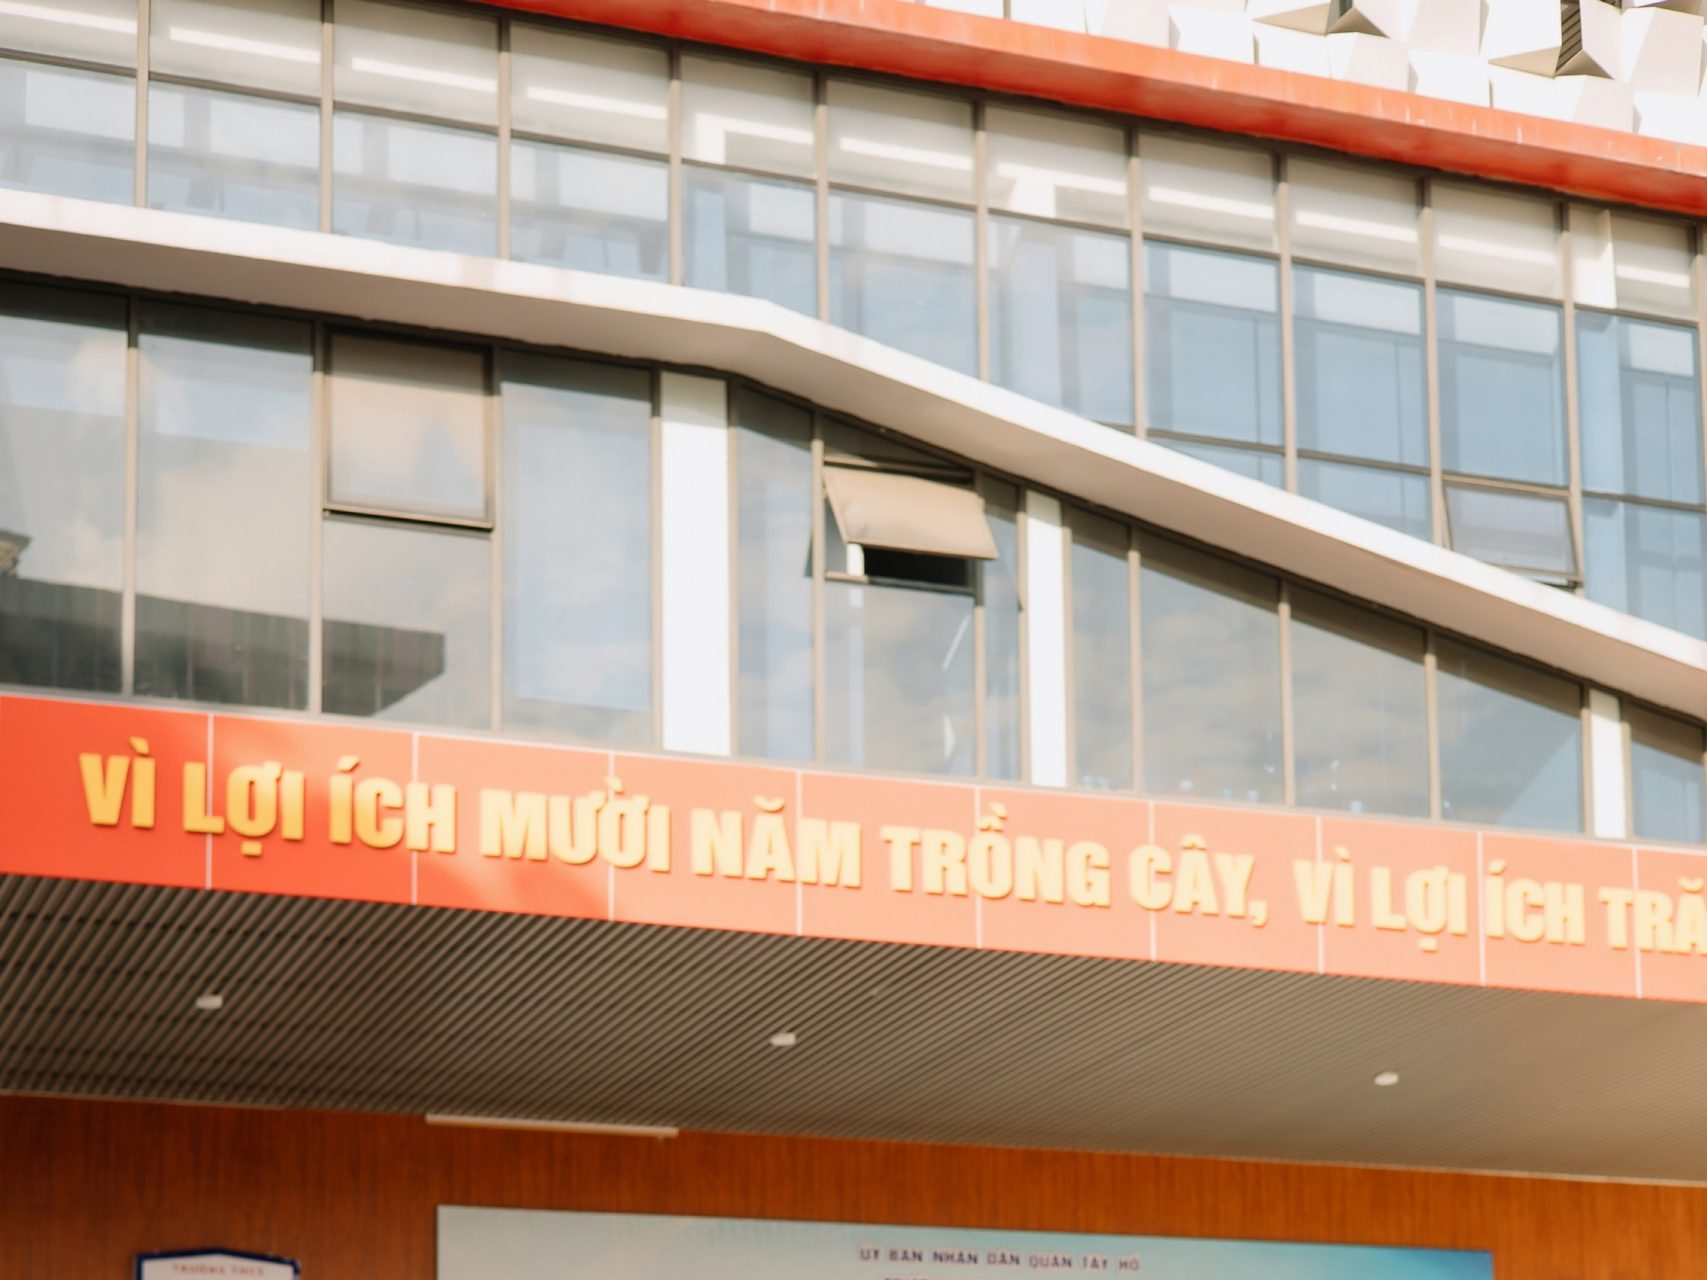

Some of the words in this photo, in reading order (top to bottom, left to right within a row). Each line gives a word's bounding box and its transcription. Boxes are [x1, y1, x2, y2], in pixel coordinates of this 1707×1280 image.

[79, 737, 155, 829] VÌ
[183, 760, 304, 857] LỢI
[328, 755, 457, 853] ÍCH
[479, 776, 670, 872] MƯỜI
[690, 795, 862, 888] NĂM
[881, 803, 1110, 907] TRỒNG
[1128, 836, 1268, 927] CÂY,
[1293, 846, 1355, 926] VÌ
[1370, 867, 1467, 952] LỢI
[1486, 860, 1585, 946] ÍCH
